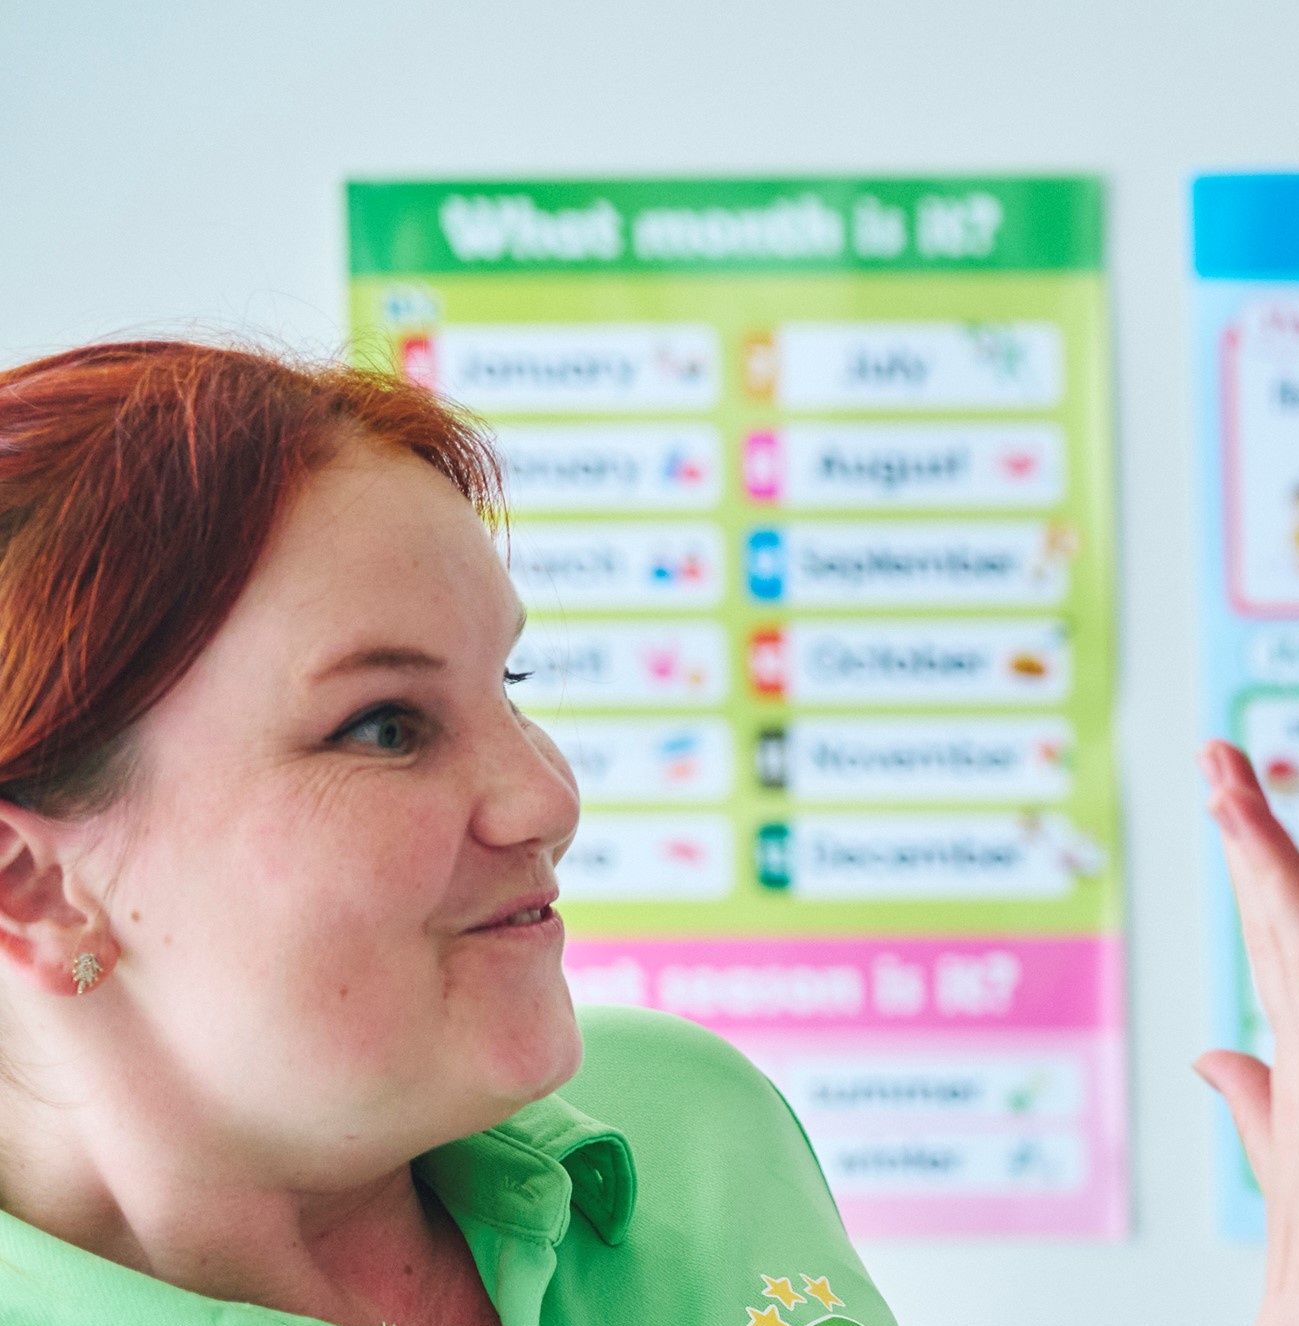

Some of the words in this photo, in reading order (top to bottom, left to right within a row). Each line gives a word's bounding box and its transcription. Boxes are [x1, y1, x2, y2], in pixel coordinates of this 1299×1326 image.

[443, 196, 622, 257] What
[636, 197, 842, 256] month
[855, 197, 904, 256] is
[918, 196, 1000, 256] it?
[458, 346, 641, 392] January
[842, 341, 936, 390] July
[811, 446, 970, 495] August
[798, 540, 1025, 590] September
[806, 640, 992, 682] October
[805, 735, 1027, 779] November
[807, 831, 1029, 875] December
[657, 966, 863, 1012] season
[874, 955, 925, 1013] is
[936, 953, 1018, 1013] it?
[806, 1071, 985, 1112] summer
